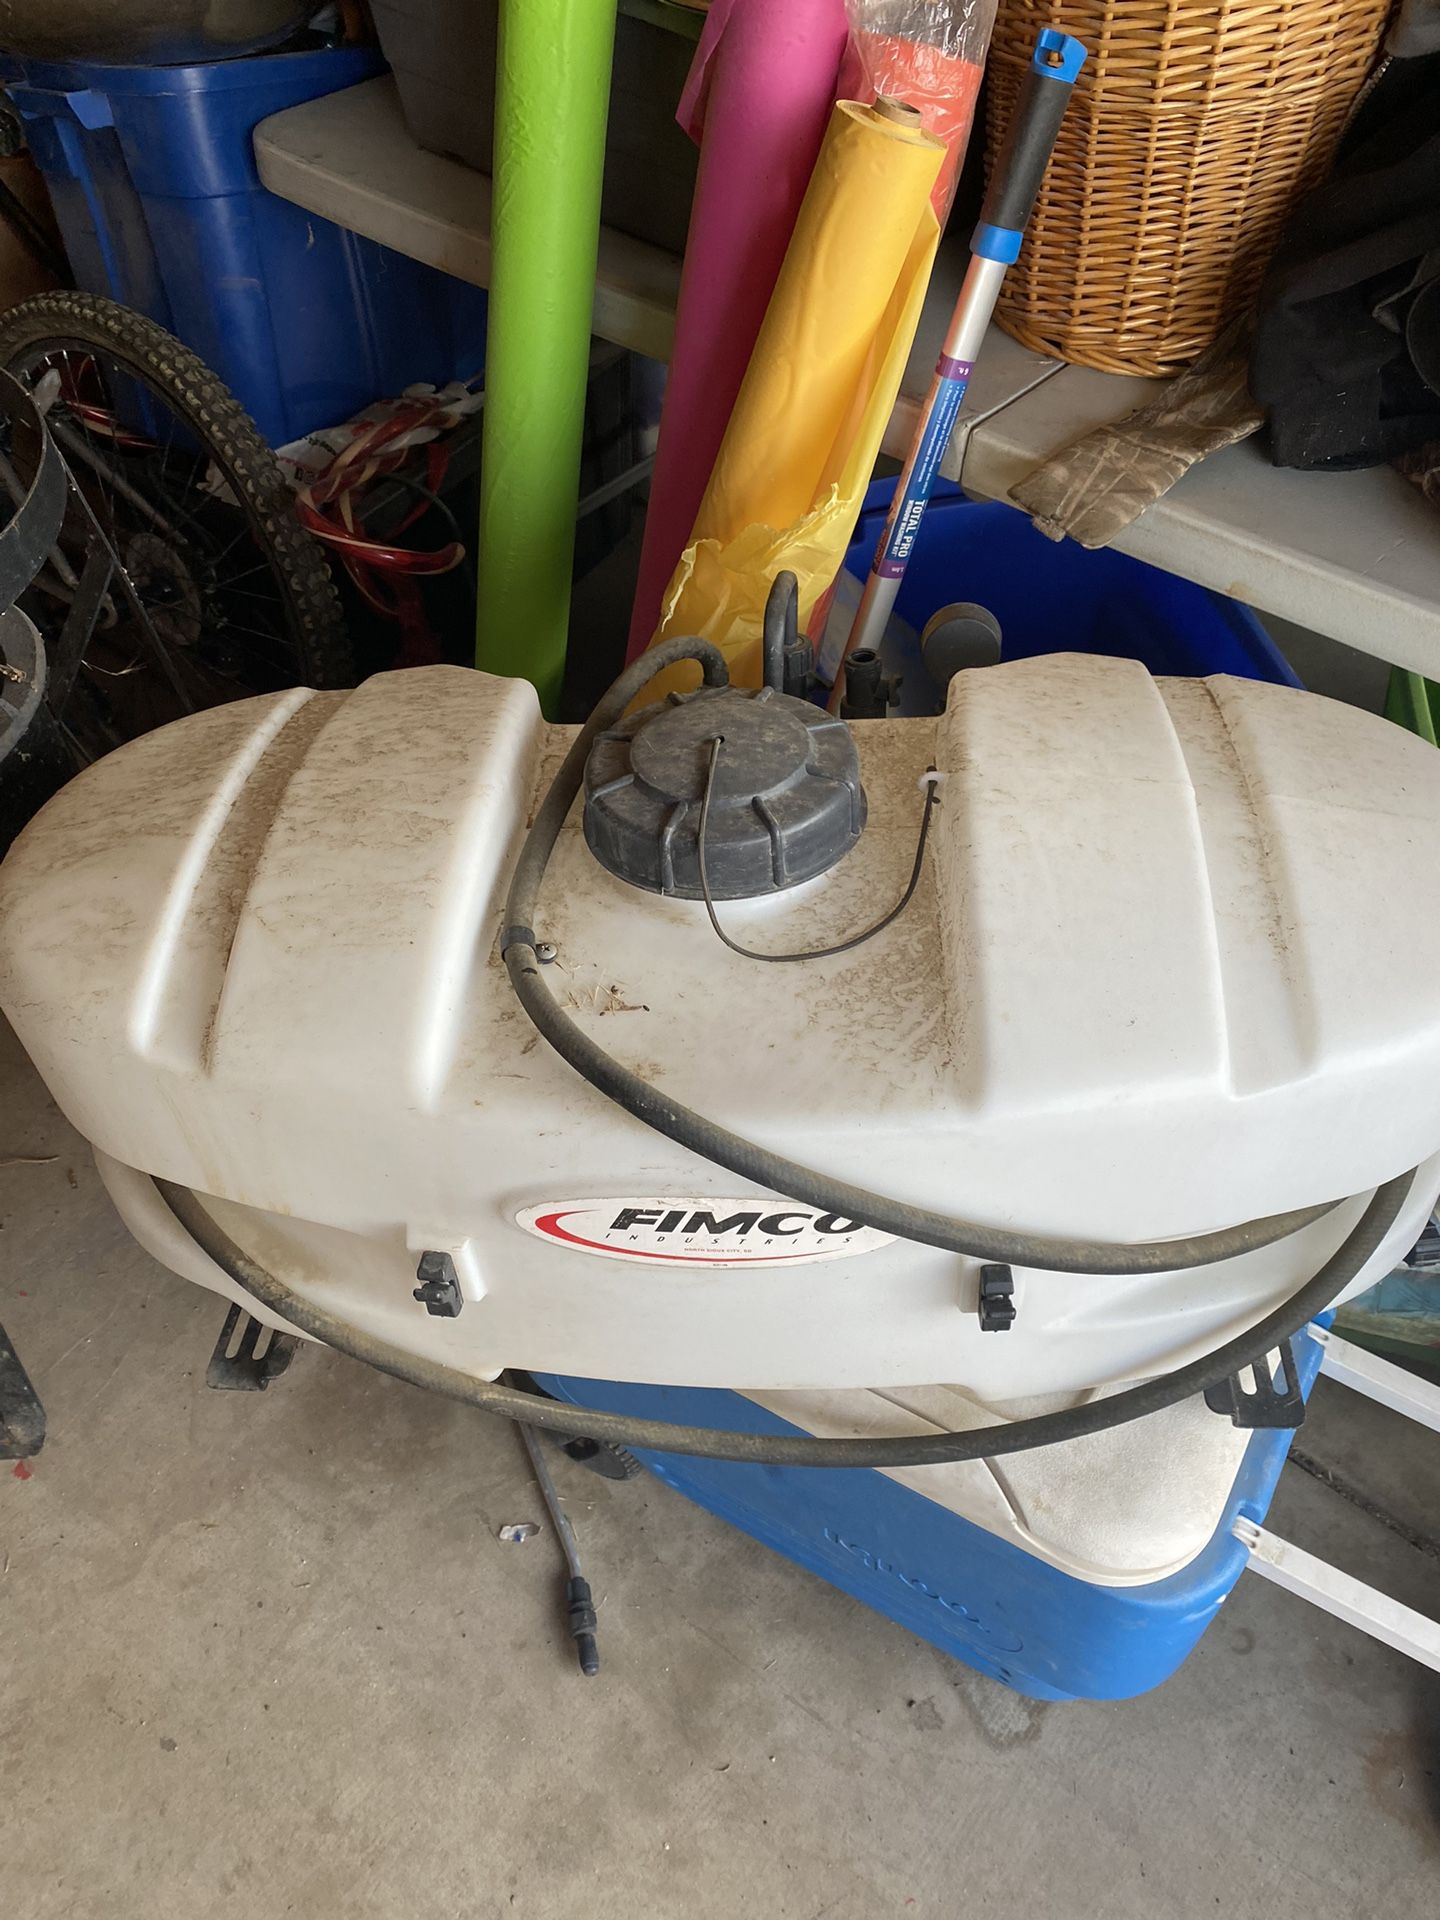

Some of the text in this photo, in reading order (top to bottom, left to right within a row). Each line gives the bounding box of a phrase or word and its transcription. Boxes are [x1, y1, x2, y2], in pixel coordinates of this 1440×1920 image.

[906, 499, 925, 533] TOTAL
[898, 535, 913, 558] PRO
[609, 1207, 865, 1236] FIMCO
[605, 1233, 851, 1245] INDUSTRIES
